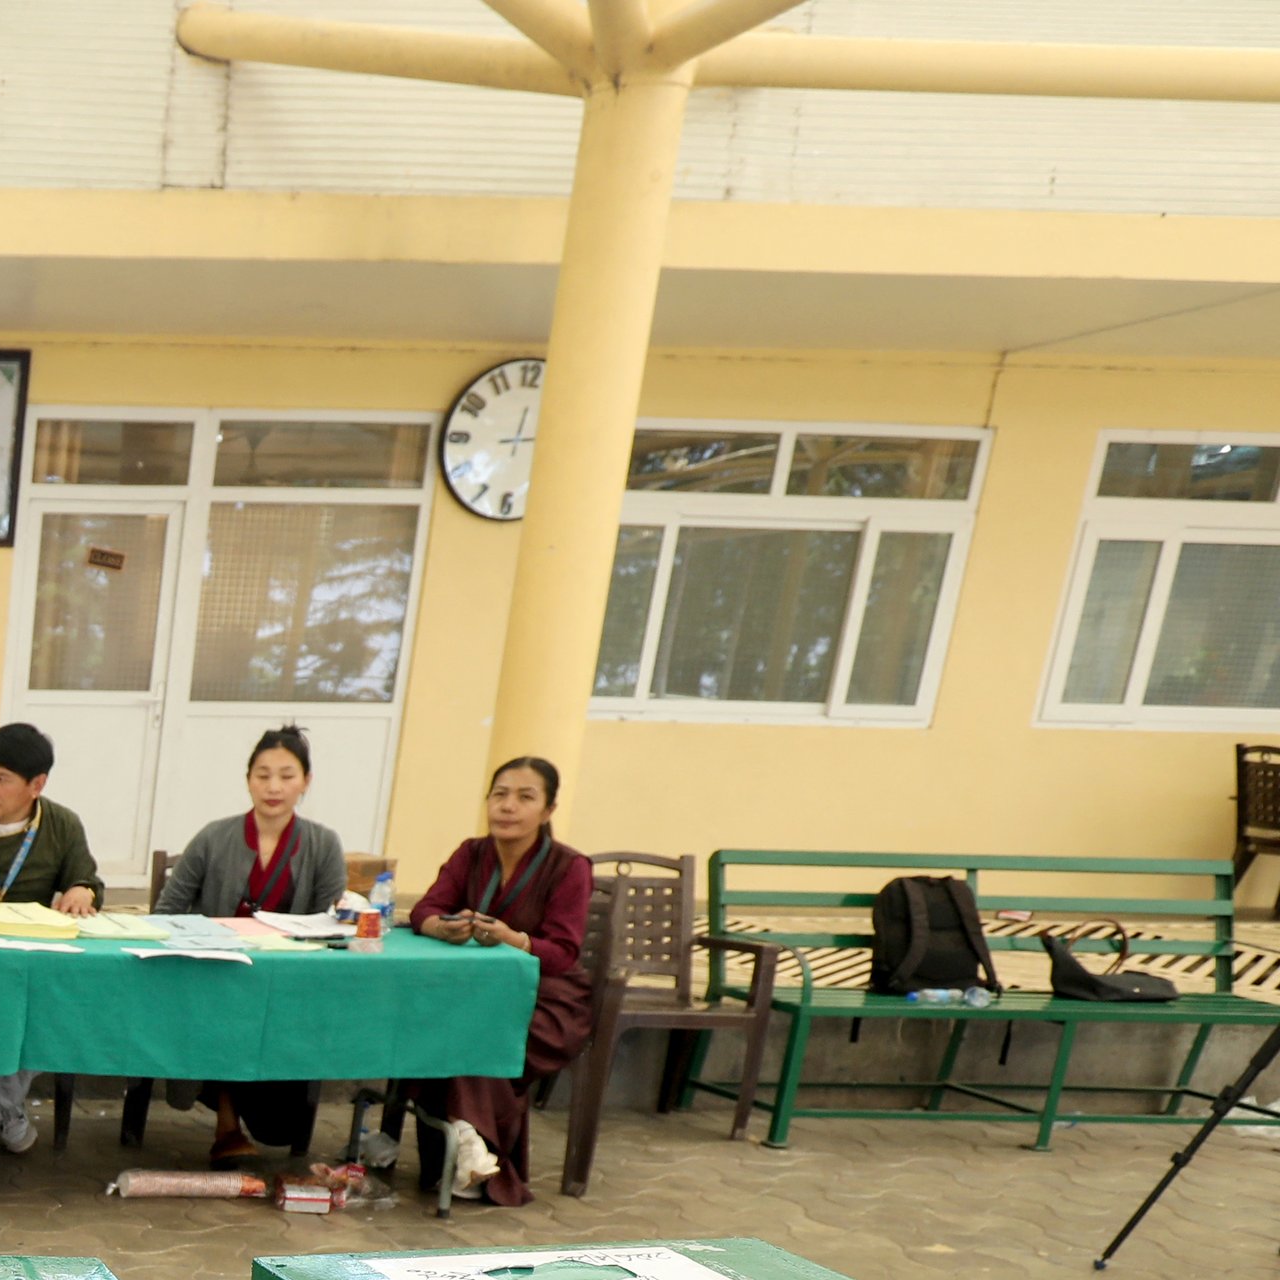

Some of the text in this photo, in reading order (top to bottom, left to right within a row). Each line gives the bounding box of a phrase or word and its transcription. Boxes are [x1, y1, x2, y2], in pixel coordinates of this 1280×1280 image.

[488, 369, 511, 395] 11
[520, 364, 542, 388] 12
[461, 392, 487, 418] 10
[449, 429, 471, 444] 9
[471, 483, 489, 503] 7
[499, 492, 514, 515] 6
